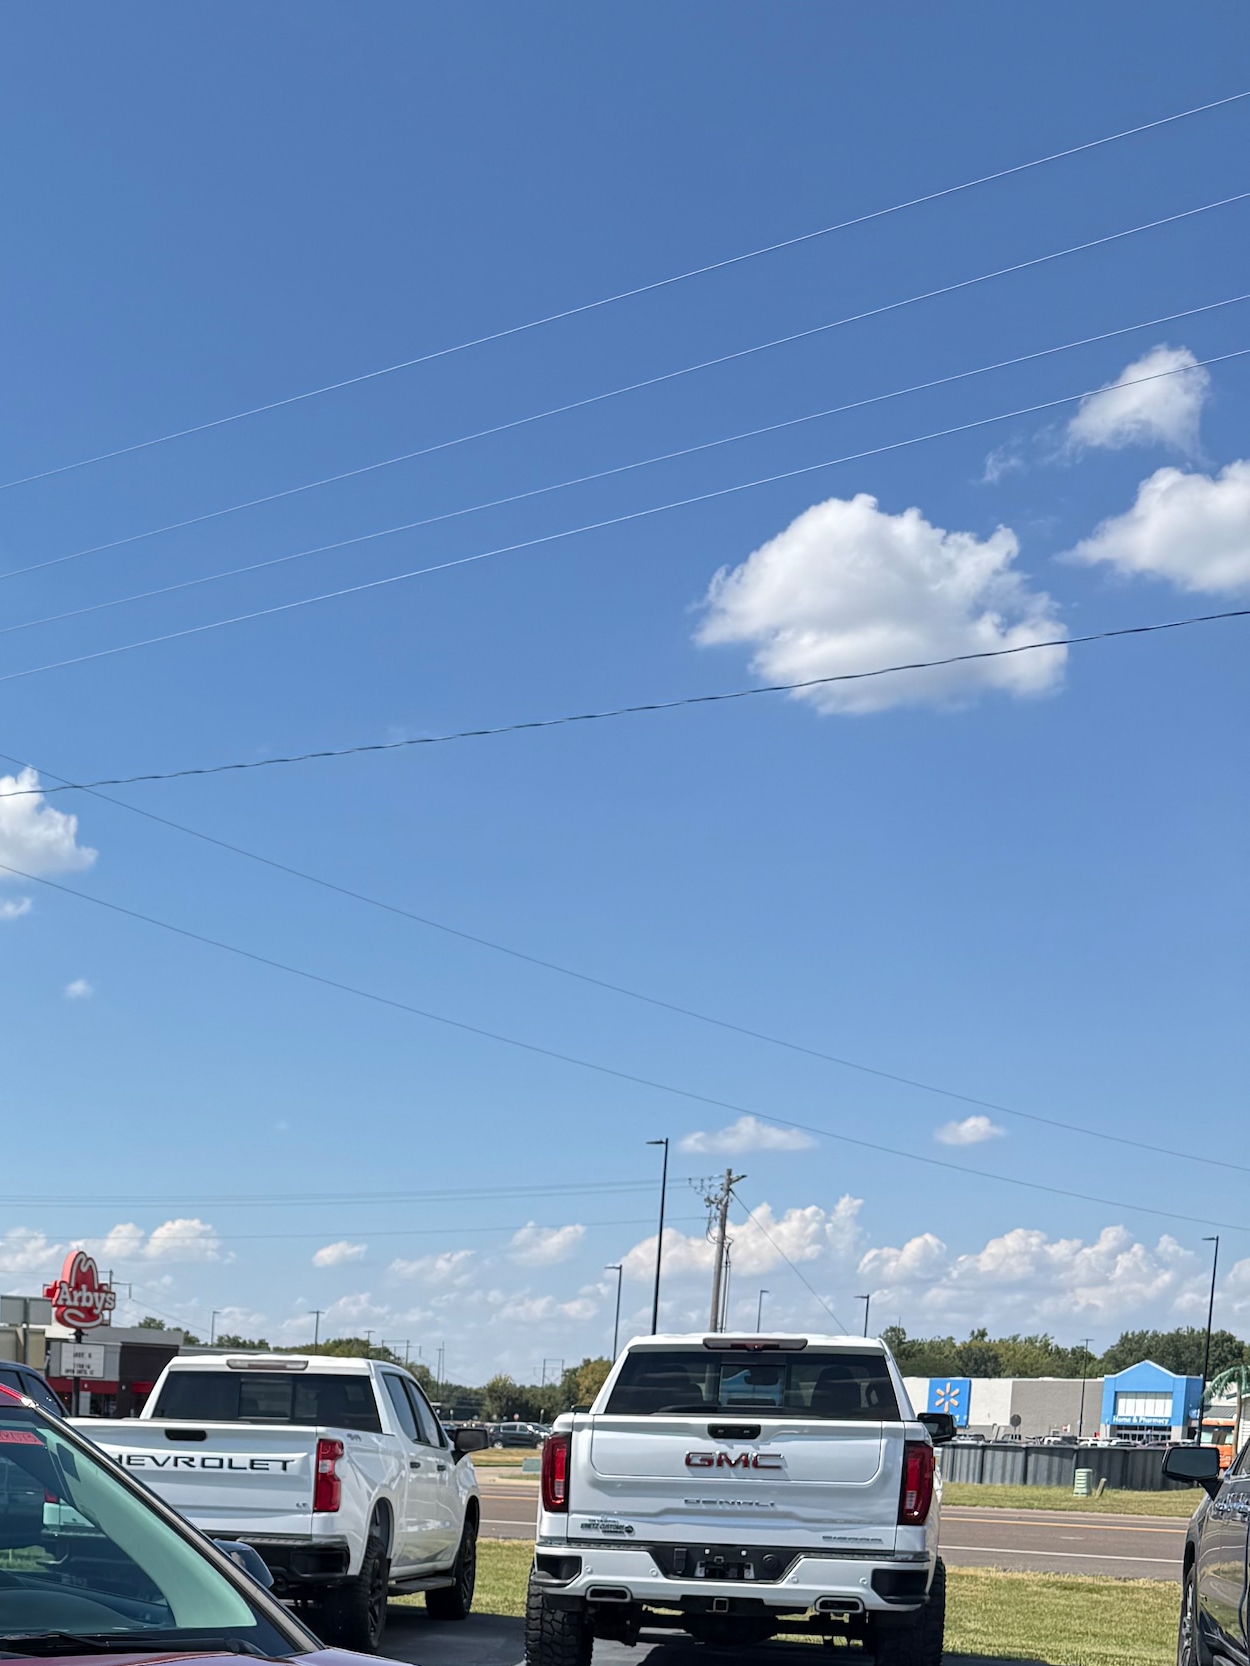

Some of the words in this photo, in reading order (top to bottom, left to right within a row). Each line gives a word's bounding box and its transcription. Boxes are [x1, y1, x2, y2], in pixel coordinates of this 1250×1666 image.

[57, 1282, 115, 1315] Arby's
[114, 1454, 295, 1472] EVROLET
[685, 1452, 783, 1470] GMC
